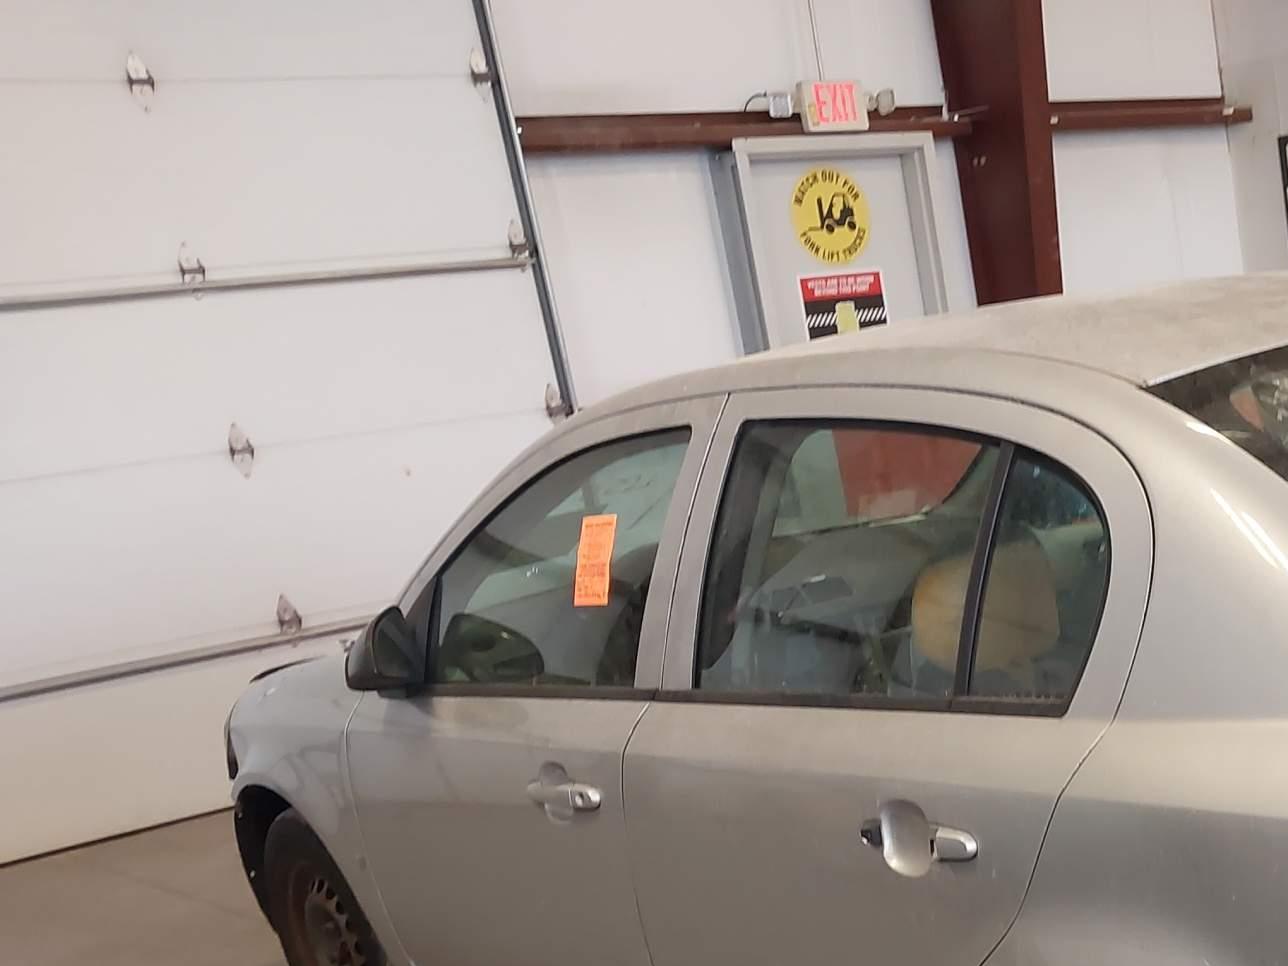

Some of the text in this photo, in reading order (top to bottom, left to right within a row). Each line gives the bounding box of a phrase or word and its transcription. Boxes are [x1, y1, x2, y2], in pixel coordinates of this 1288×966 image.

[814, 83, 857, 123] EXIT
[794, 169, 860, 207] WATCH OUT FOR
[800, 227, 867, 263] FORK LIFT TRUCKS
